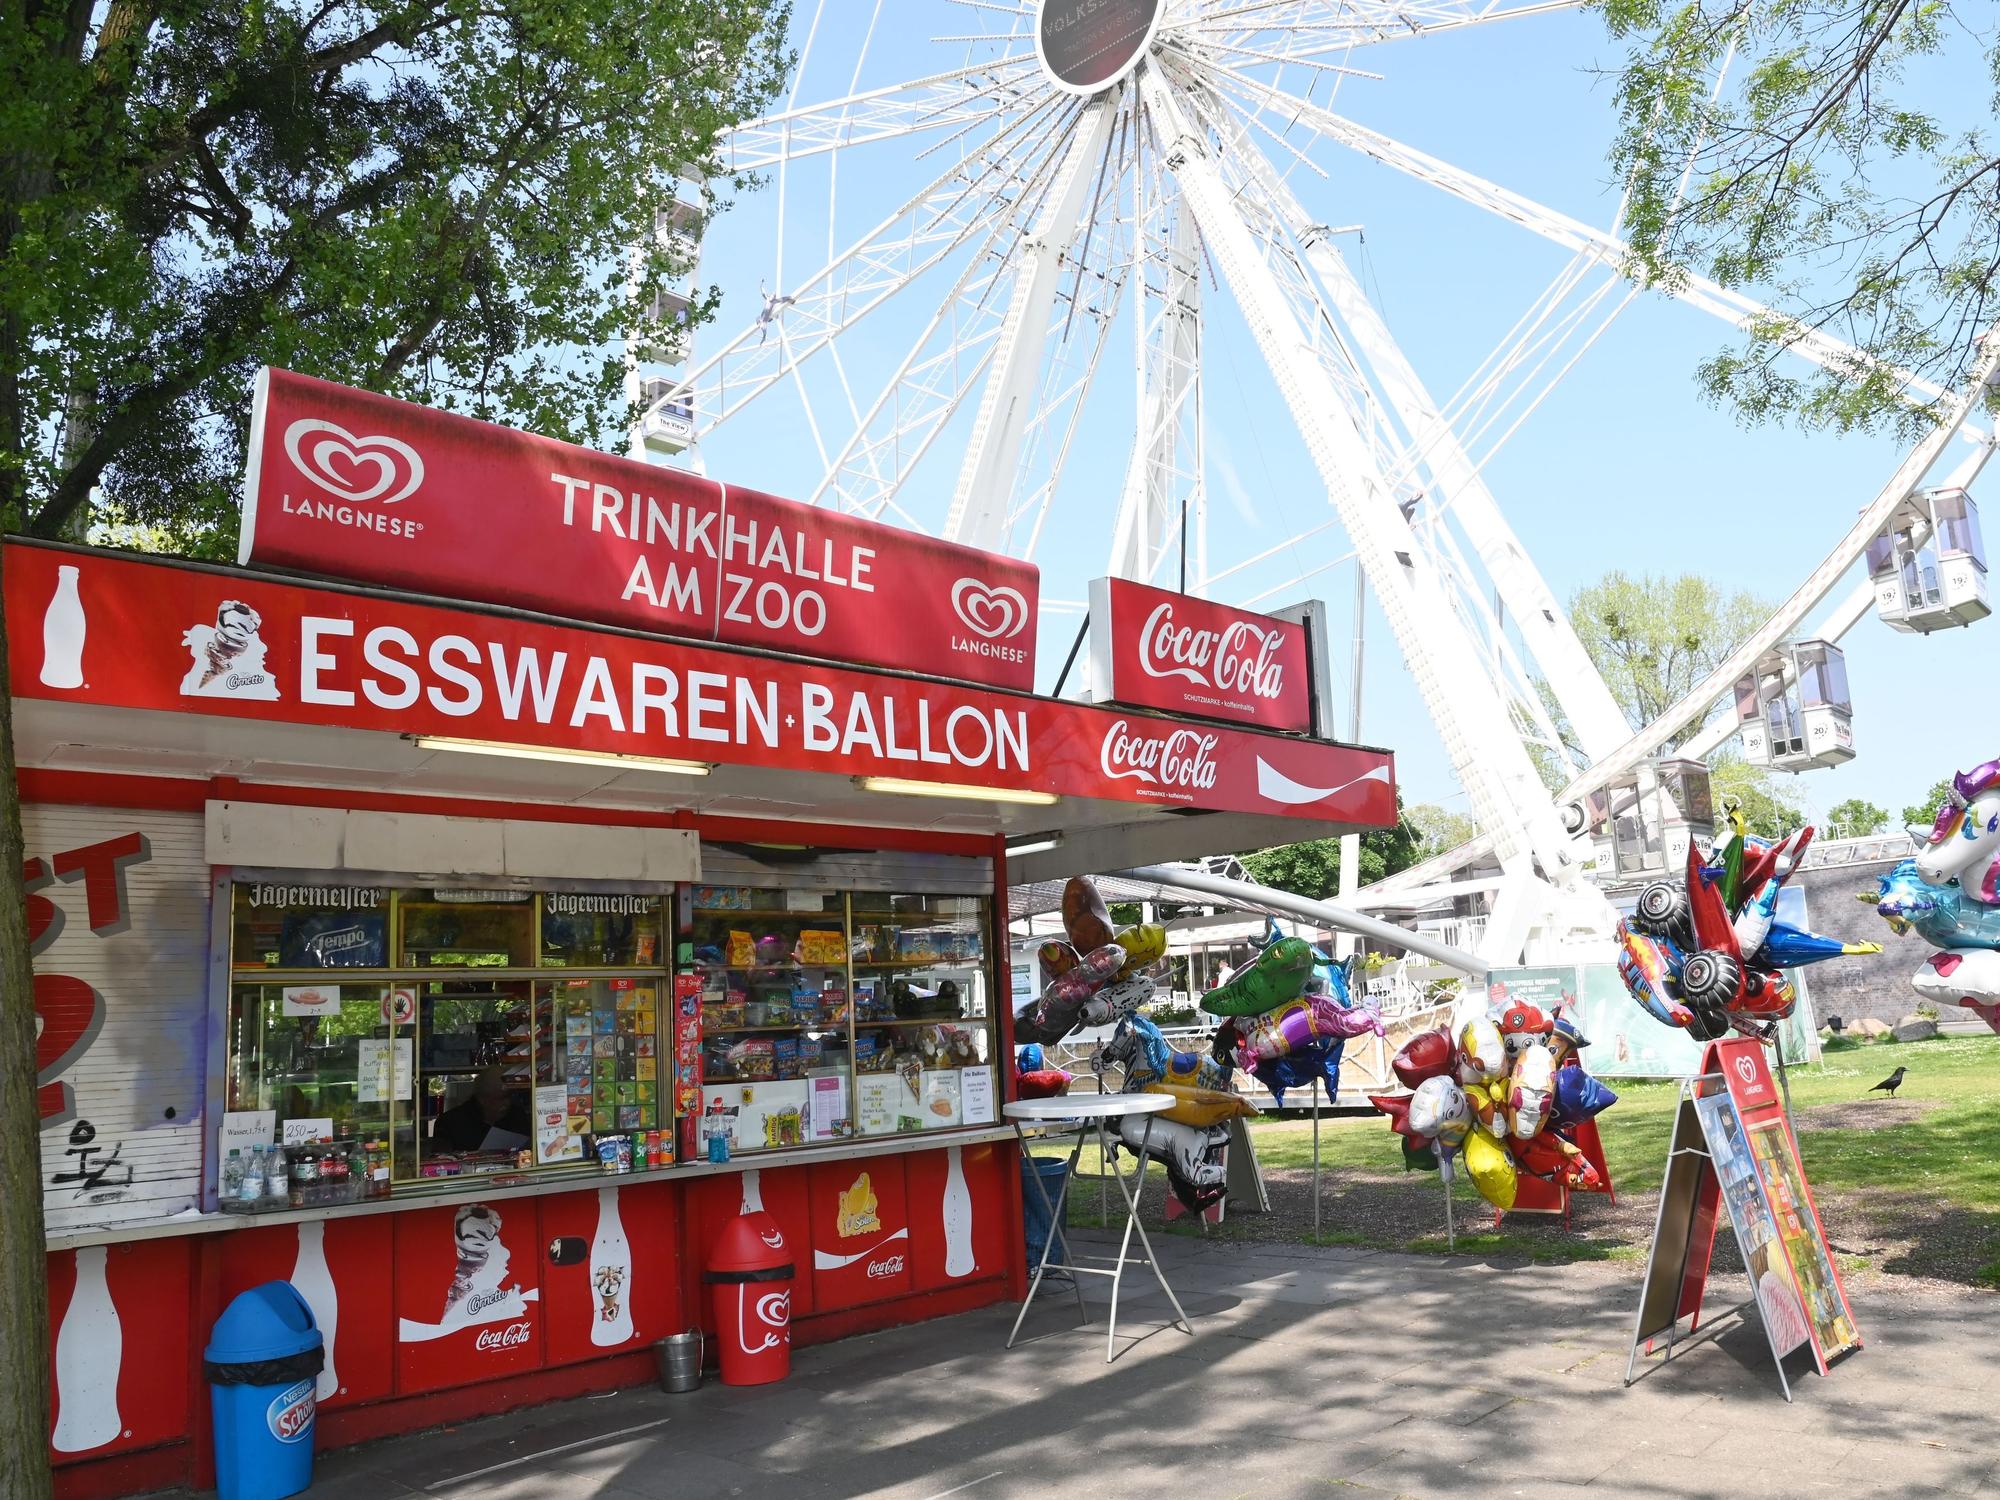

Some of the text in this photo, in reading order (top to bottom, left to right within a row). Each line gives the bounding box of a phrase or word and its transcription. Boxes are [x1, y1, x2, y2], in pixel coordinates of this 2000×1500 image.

[550, 472, 877, 594] TRINKHALLE
[620, 555, 827, 637] AM ZOO
[226, 673, 265, 691] Cornetto
[300, 615, 779, 749] ESSWAREN
[803, 681, 1030, 773] BALLON
[1183, 693, 1221, 706] SCHUTZMARKE
[314, 927, 366, 951] Tempo
[466, 1290, 508, 1316] Cornetto
